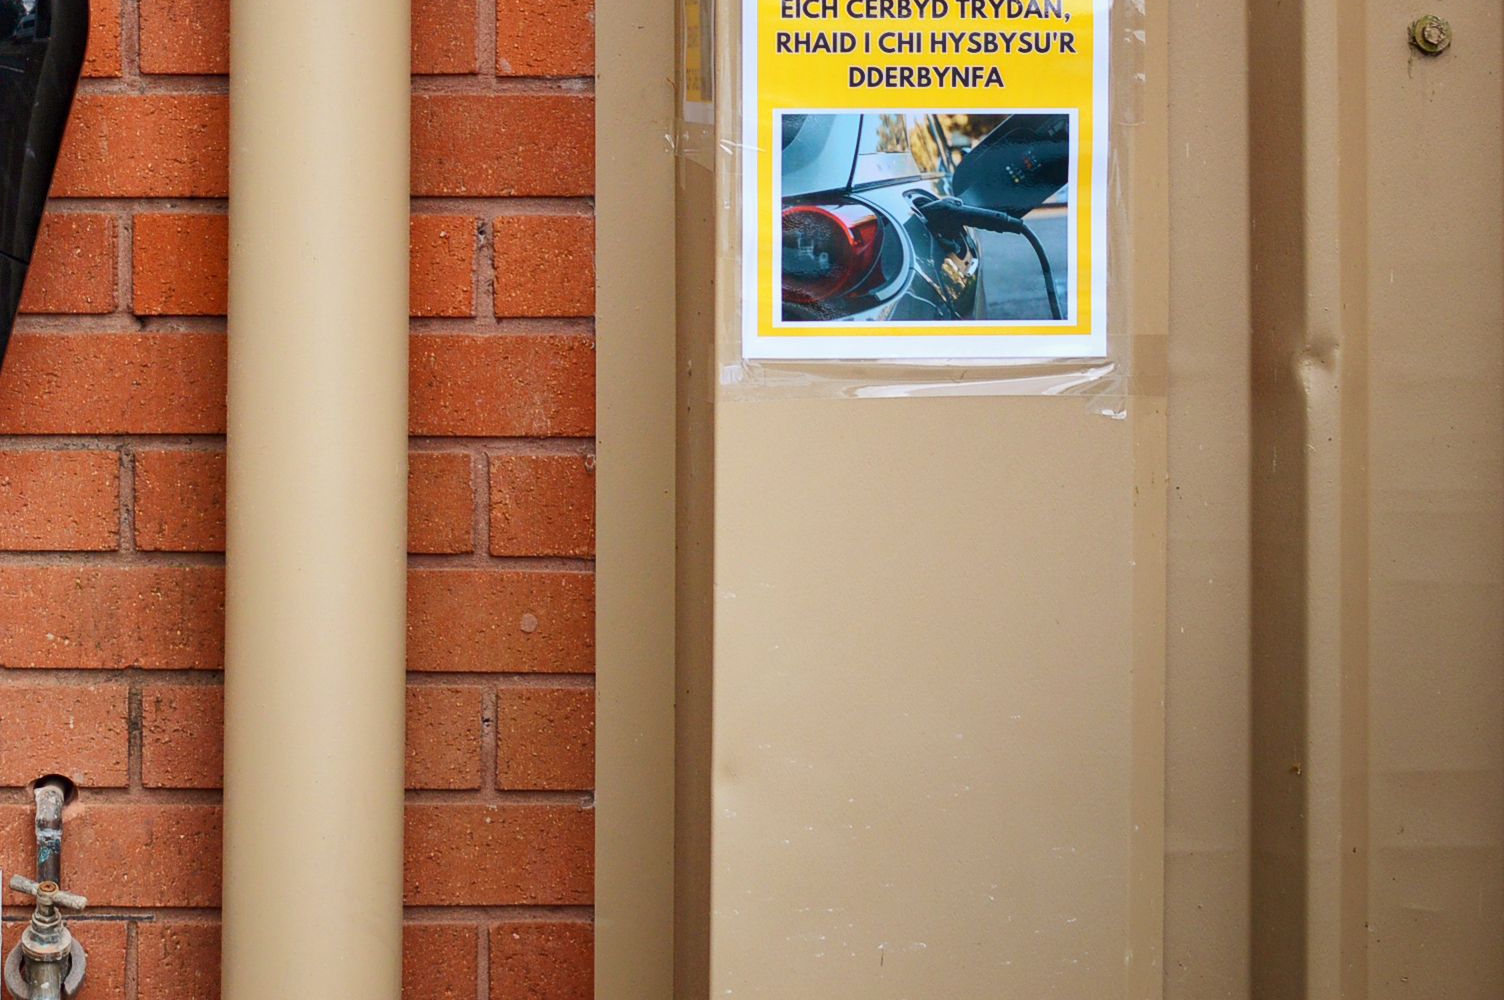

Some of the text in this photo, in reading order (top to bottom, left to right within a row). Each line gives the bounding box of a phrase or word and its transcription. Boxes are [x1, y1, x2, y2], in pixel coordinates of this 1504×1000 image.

[776, 31, 1077, 54] RHAID I CHI HYSBYSU'R
[848, 66, 1005, 88] DDERBYNFA
